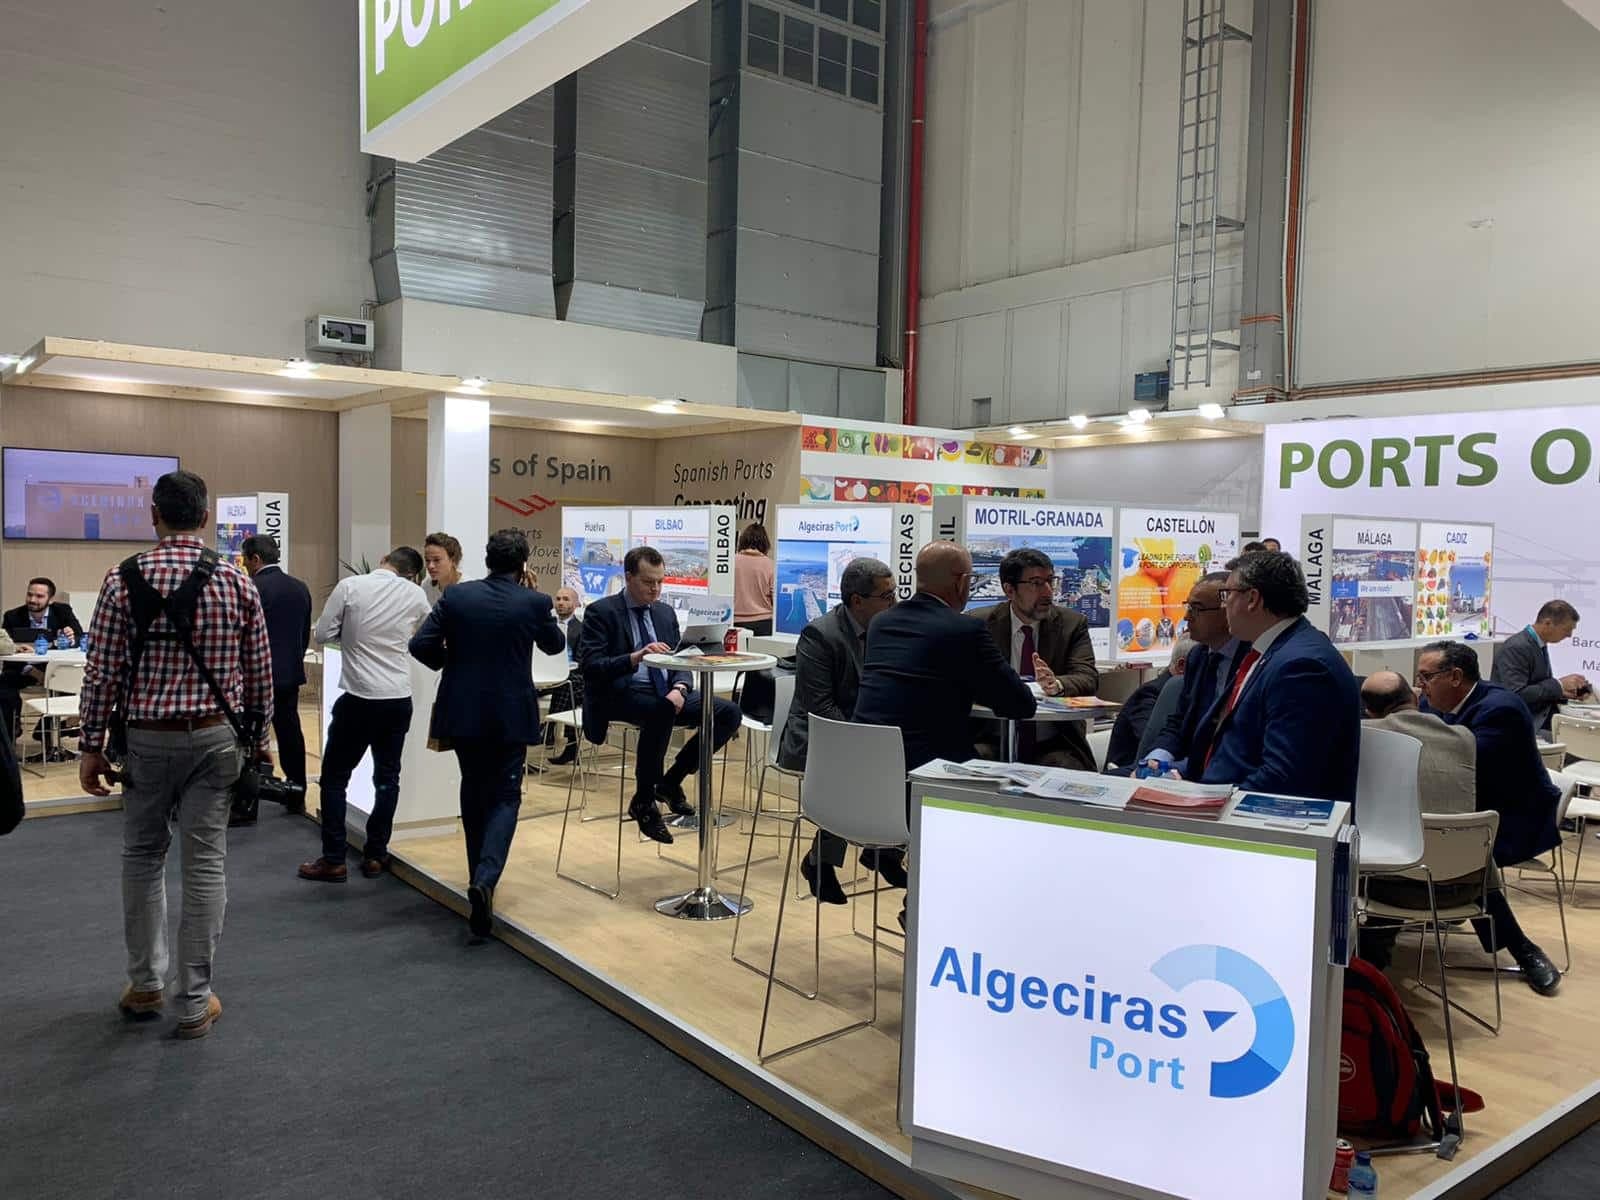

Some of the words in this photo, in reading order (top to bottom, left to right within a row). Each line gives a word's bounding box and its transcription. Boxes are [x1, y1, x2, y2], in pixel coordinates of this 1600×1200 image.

[512, 453, 538, 476] of
[546, 456, 610, 484] Spain
[673, 461, 729, 490] Spanish
[734, 459, 773, 481] Ports
[1279, 432, 1499, 489] PORTS
[655, 519, 684, 531] BILBAO
[798, 521, 834, 534] Algeciras
[835, 521, 852, 532] Port
[975, 508, 1103, 528] MOTRIL-GRANADA
[1146, 515, 1215, 534] CASTELLÓN
[716, 514, 730, 574] BILBAO
[1357, 529, 1392, 545] MÁLAGA
[930, 946, 1188, 1039] Algeciras
[1089, 1035, 1185, 1090] Port
